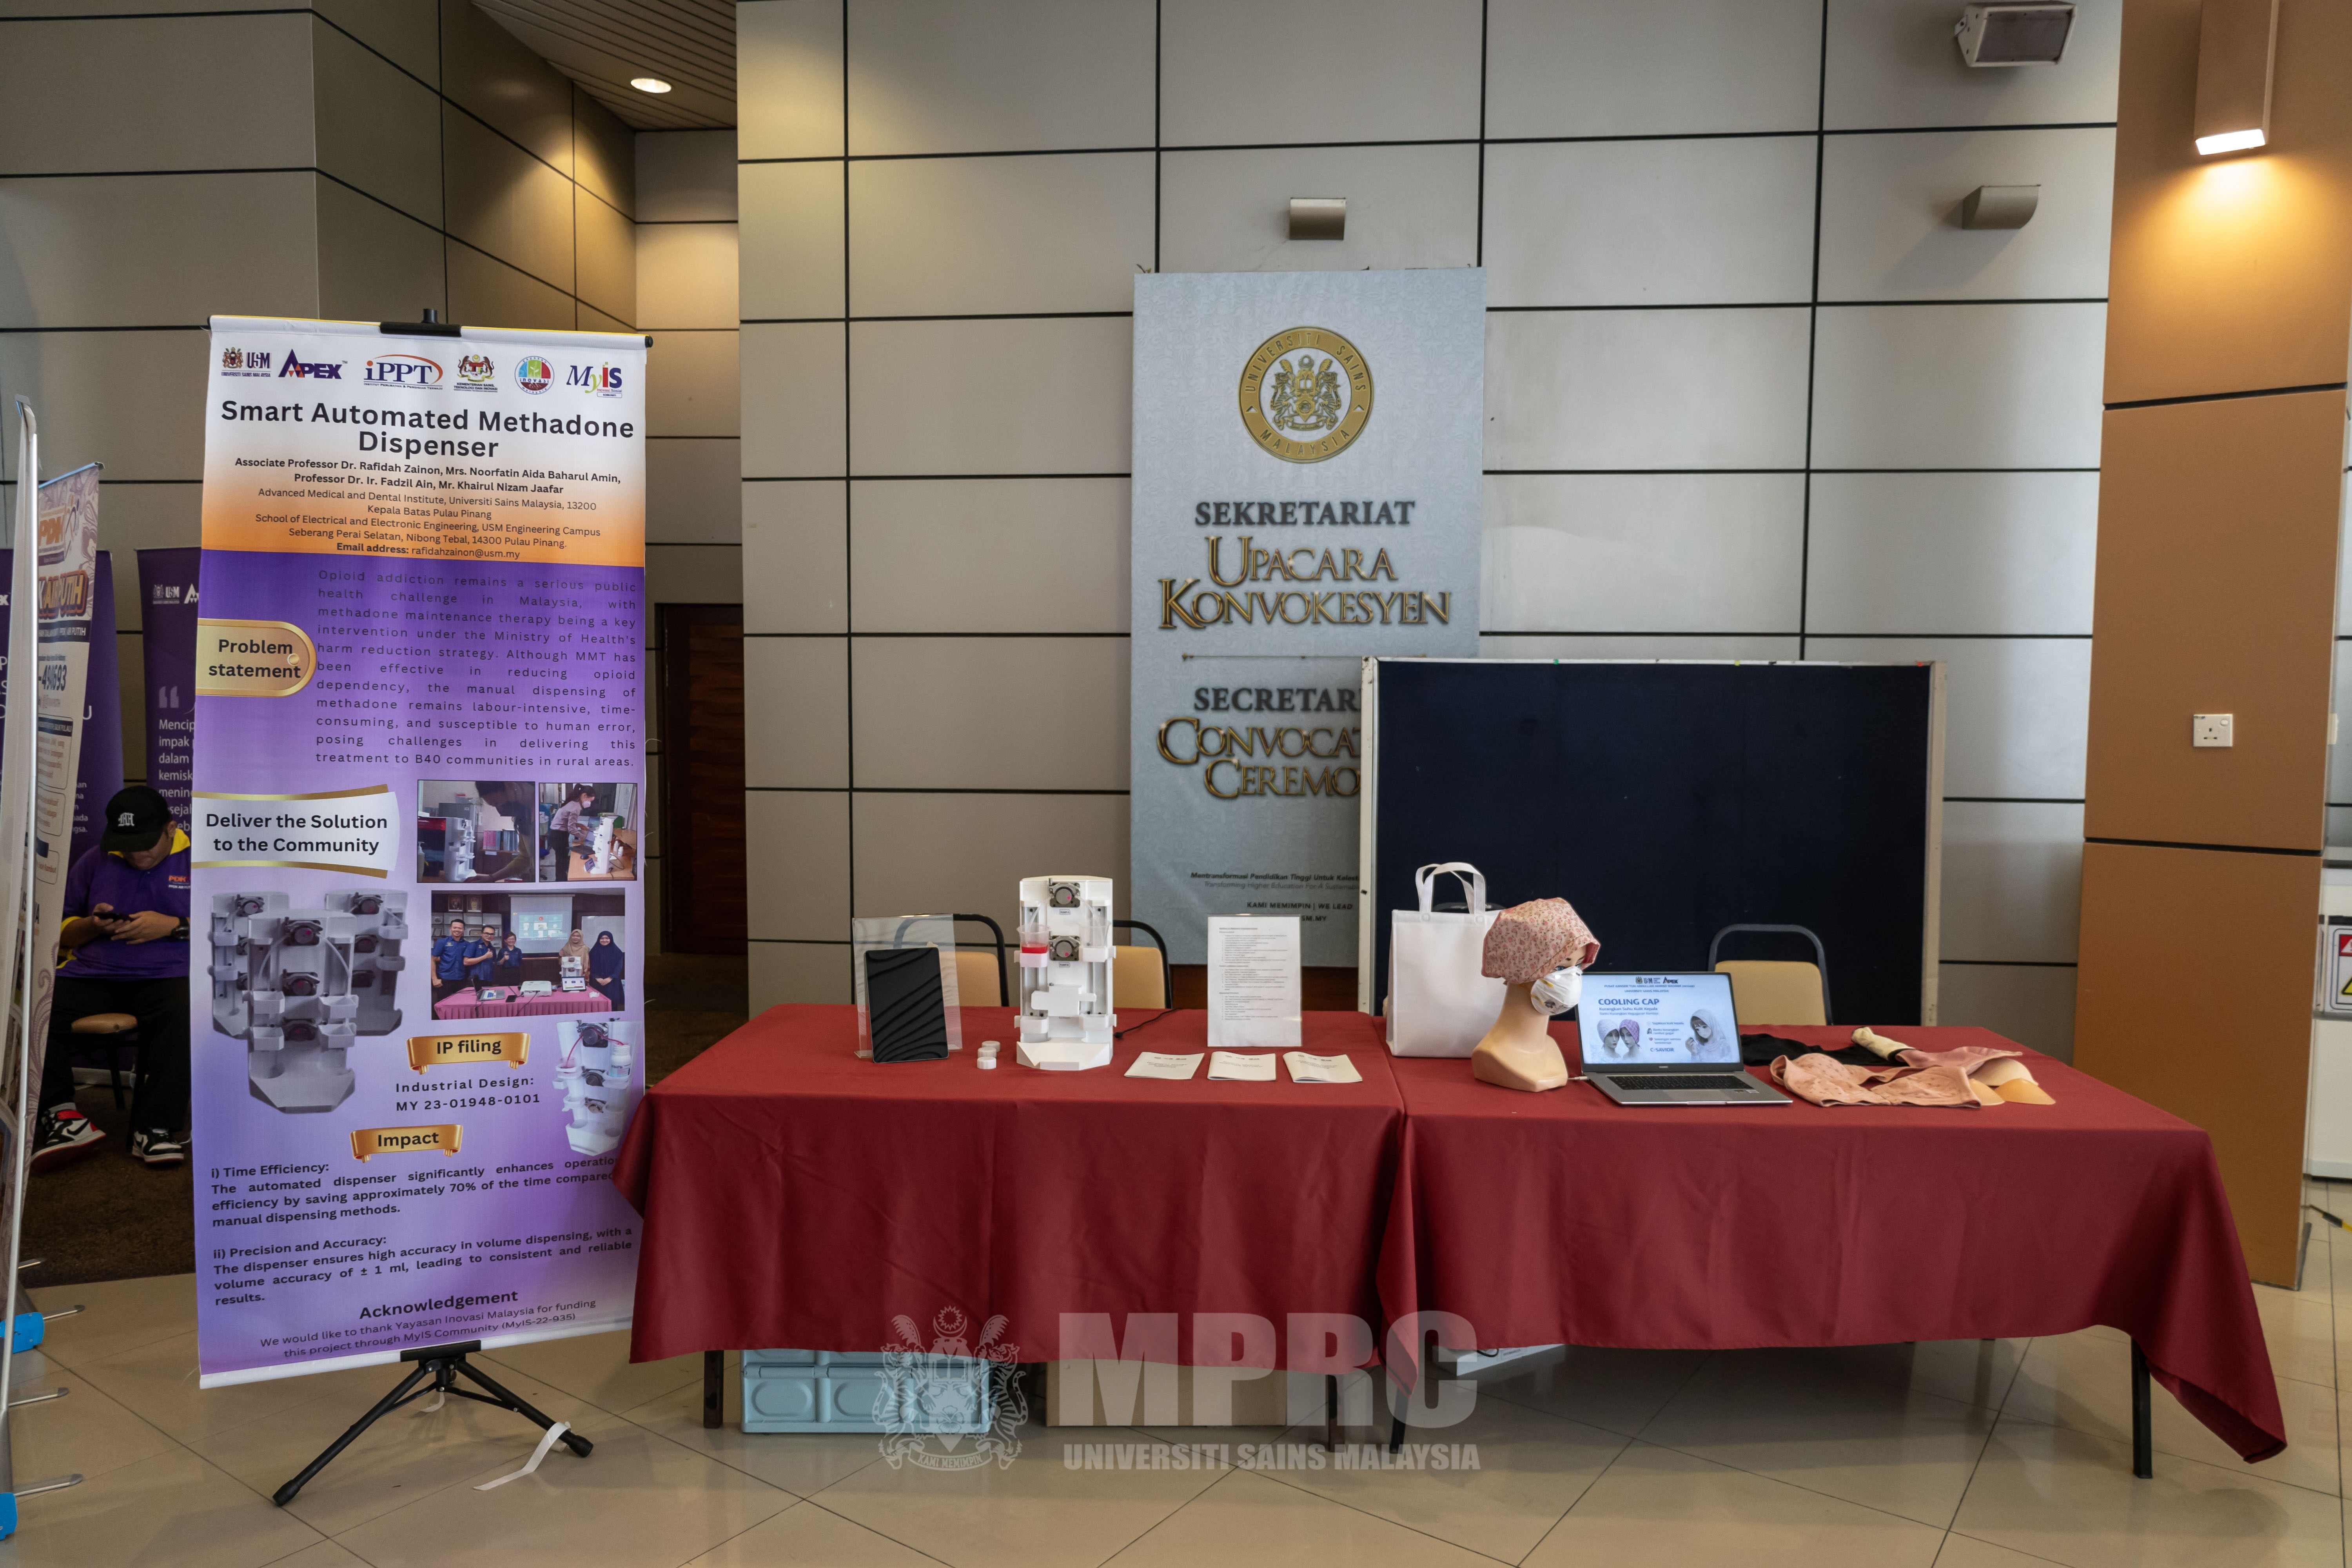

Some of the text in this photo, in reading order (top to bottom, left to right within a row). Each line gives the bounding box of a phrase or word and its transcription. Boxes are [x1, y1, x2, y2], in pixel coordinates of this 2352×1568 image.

[247, 352, 270, 369] USM
[278, 348, 342, 379] APEX
[221, 401, 633, 437] Smart Automated Methadone
[360, 431, 499, 459] Dispenser
[1259, 428, 1351, 456] MALAYSIA
[235, 458, 285, 467] Associate
[288, 459, 338, 468] Professor
[360, 462, 401, 472] Rafidah
[404, 465, 443, 476] Zainon,
[470, 468, 519, 477] Noorfatin
[522, 470, 545, 478] Aida
[548, 471, 588, 481] Baharul
[591, 474, 620, 484] Amin,
[295, 474, 345, 483] Professor
[348, 475, 363, 484] Dr.
[381, 477, 412, 487] Fadzil
[416, 480, 436, 490] Ain,
[458, 481, 494, 490] Khairul
[497, 483, 528, 492] Nizam
[531, 485, 563, 493] Jaafar
[259, 488, 305, 497] Advanced
[308, 490, 345, 498] Medical
[369, 492, 401, 501] Dental
[405, 495, 446, 505] Institute,
[449, 497, 492, 505] Universiti
[495, 498, 519, 506] Sains
[522, 499, 564, 510] Malaysia,
[567, 502, 596, 510] 13200
[1195, 501, 1416, 526] SEKRETARIAT
[337, 543, 520, 559] Email address: rafidahzainon@usm.my
[1205, 535, 1399, 586] UPACARA
[1158, 578, 1450, 629] KONVOKESYEN
[219, 639, 292, 654] Problem
[209, 663, 301, 678] statement
[317, 699, 635, 715] methadone remains labour-intensive, time-
[1194, 688, 1361, 711] SECRETAR
[159, 736, 189, 749] impak
[159, 753, 189, 763] dalam
[316, 753, 388, 762] treatment
[416, 755, 440, 763] B40
[447, 756, 533, 765] communities
[540, 757, 550, 765] in
[557, 757, 589, 765] rural
[207, 813, 272, 827] Deliver
[276, 814, 306, 828] the
[311, 815, 387, 828] Solution
[214, 837, 379, 855] to the Community
[437, 1040, 501, 1054] IP filing
[396, 1077, 533, 1092] Industrial Design:
[397, 1094, 539, 1111] MY 23-01948-0101
[378, 1133, 439, 1149] Impact
[212, 1164, 328, 1179] i) Time Efficiency:
[214, 1237, 386, 1259] ii) Precision and Accuracy:
[359, 1291, 518, 1319] Acknowledgement
